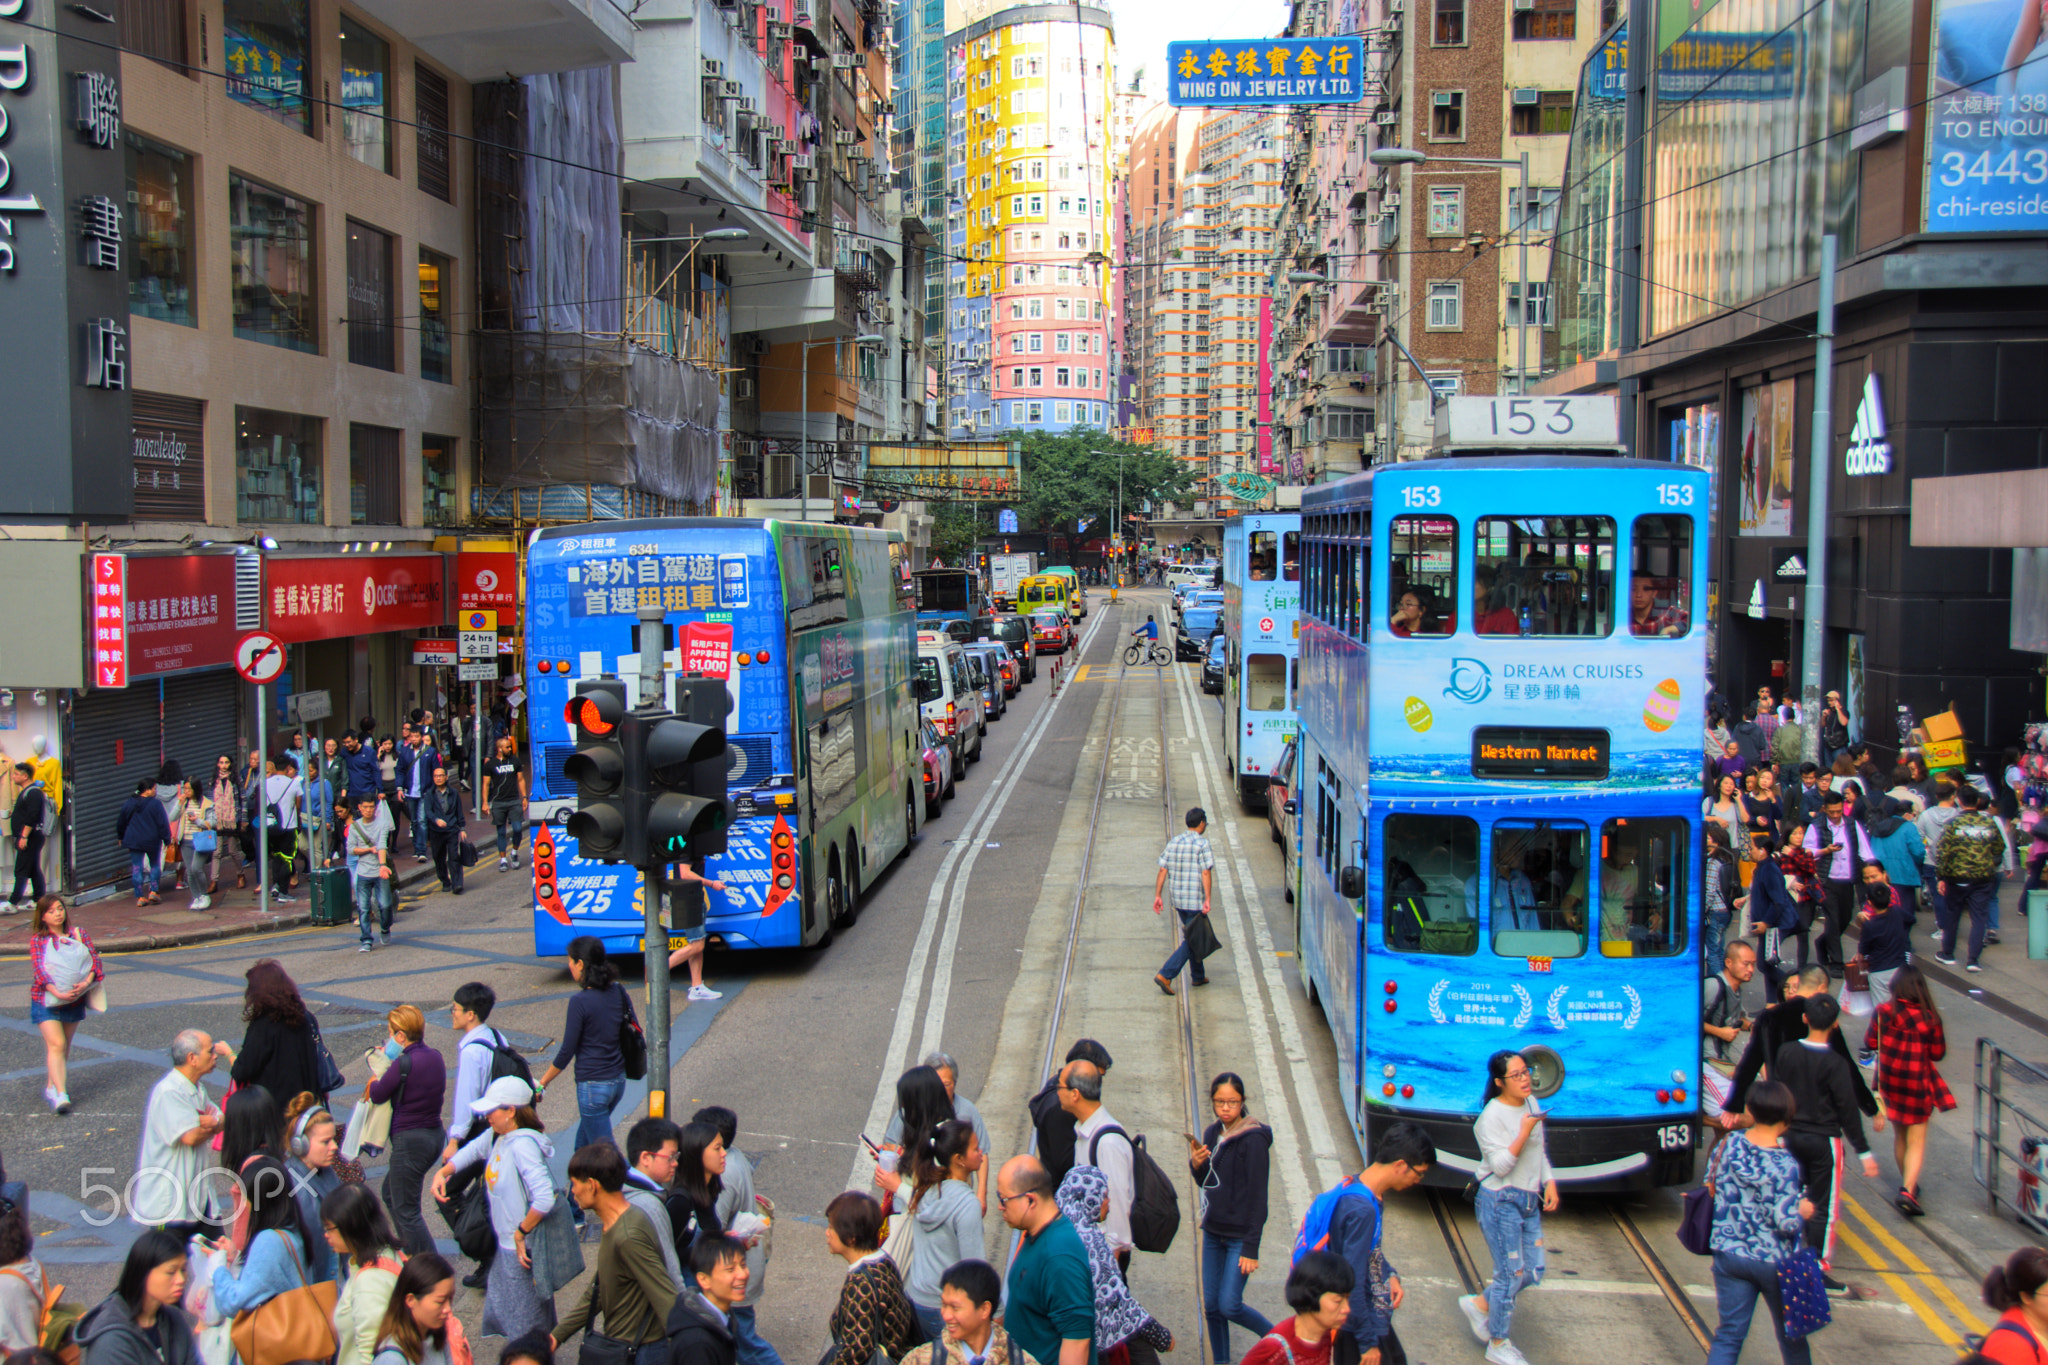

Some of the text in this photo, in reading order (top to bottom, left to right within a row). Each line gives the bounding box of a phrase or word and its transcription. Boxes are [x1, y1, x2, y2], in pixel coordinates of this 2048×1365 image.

[1177, 45, 1353, 79] 永安珠寶金行
[1178, 78, 1353, 98] WING ON JEWELRY LTD.
[1943, 96, 2003, 115] 太極軒
[1941, 121, 1972, 138] TO
[348, 277, 379, 311] Reading
[1490, 399, 1574, 436] 153
[132, 428, 187, 467] nowledge
[1846, 439, 1891, 476] adidas
[1401, 485, 1442, 508] 153
[1656, 483, 1694, 506] 153
[581, 538, 617, 549] 租租車
[629, 543, 659, 556] 6341
[104, 559, 114, 578] $
[582, 555, 715, 586] 海外自駕遊
[1776, 567, 1807, 576] adidas
[274, 583, 345, 618] 華僑永亨銀行
[376, 585, 398, 606] OCBC
[420, 582, 440, 602] HANG
[462, 593, 513, 601] 華僑永亨銀行
[583, 583, 716, 615] 首選租租車
[725, 589, 744, 599] APP
[158, 620, 174, 630] MONEY
[175, 618, 198, 629] EXCHANGE
[199, 616, 218, 626] COMPANY
[464, 634, 493, 642] 24 hrs
[497, 637, 514, 653] csl
[467, 644, 490, 655] 全日
[689, 659, 727, 673] $1,000
[1503, 664, 1644, 679] DREAM CRUISES
[105, 667, 118, 685] ¥
[1504, 684, 1581, 700] 星夢郵輪
[1481, 744, 1599, 761] Western Market
[556, 875, 620, 890] 澳洲租車
[1528, 961, 1550, 972] S05
[1463, 1004, 1497, 1014] 世界十大
[1455, 1014, 1505, 1026] 最佳大型郵輪
[1658, 1124, 1690, 1149] 153
